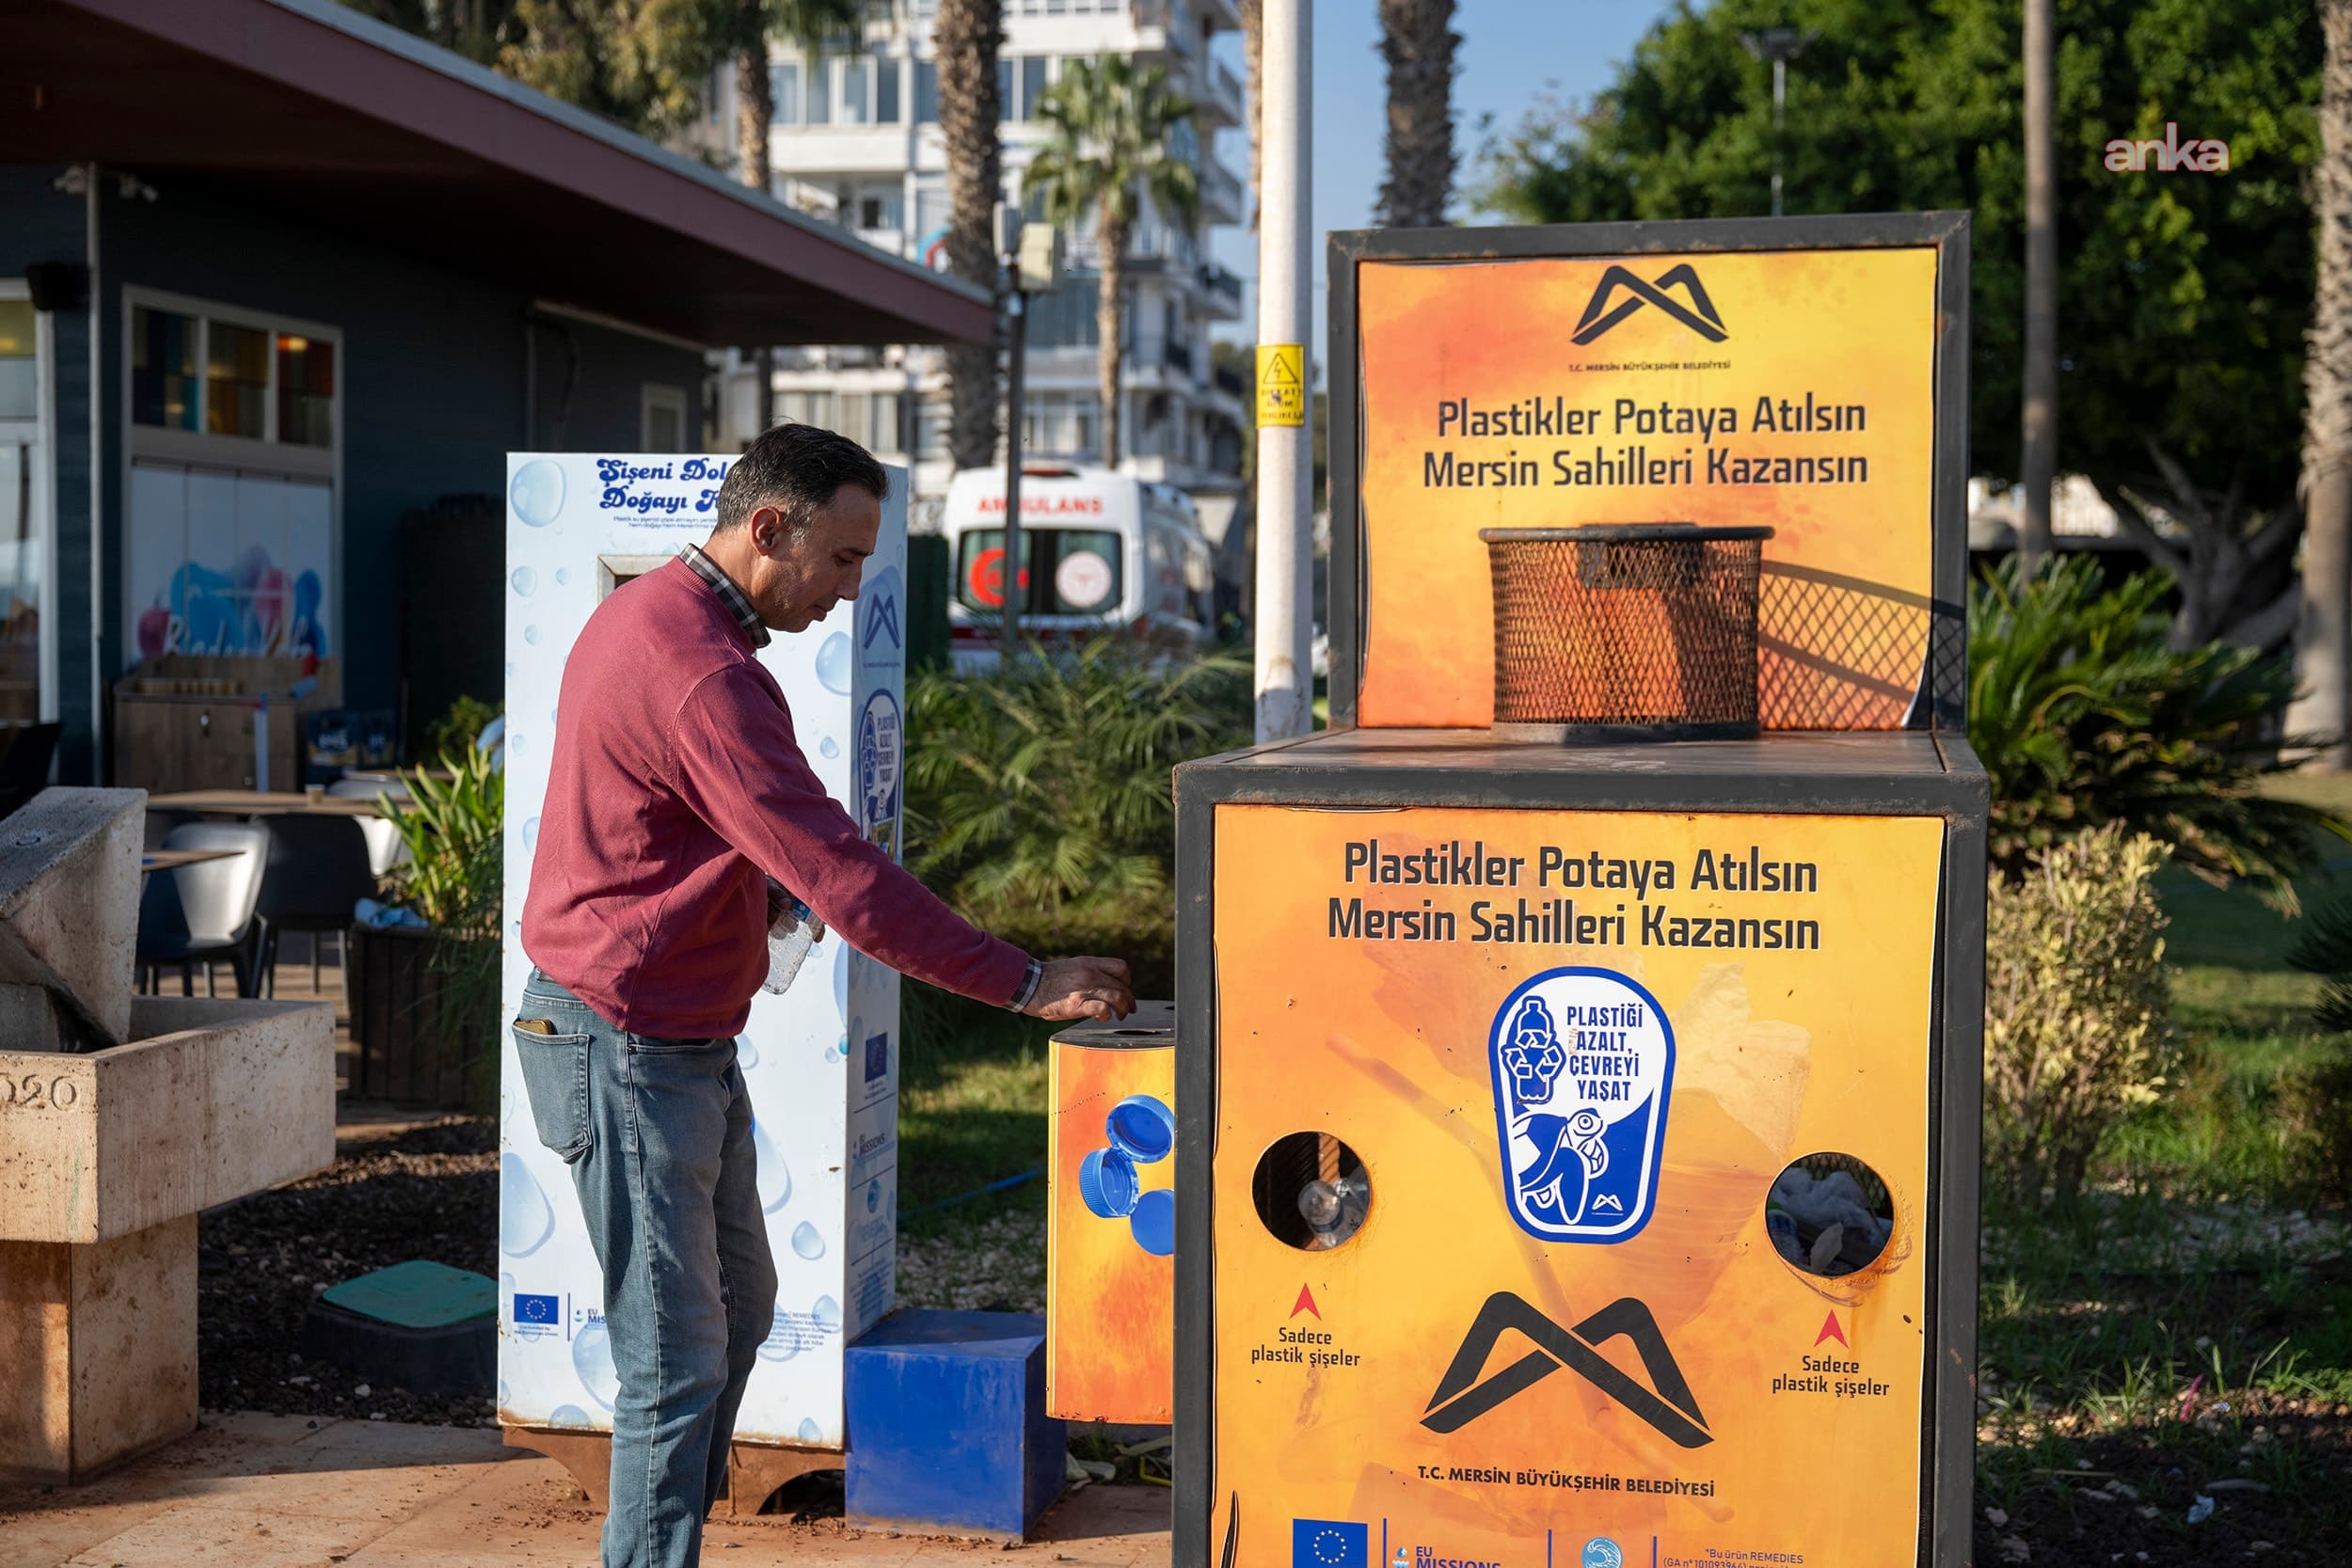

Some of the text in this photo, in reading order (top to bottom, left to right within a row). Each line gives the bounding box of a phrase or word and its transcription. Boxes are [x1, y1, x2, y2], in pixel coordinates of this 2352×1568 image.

[1438, 392, 1866, 444] Plastikler Potaya Atılsın
[596, 457, 727, 487] Şişeni Dol
[1423, 446, 1867, 487] Mersin Sahilleri Kazansın
[599, 485, 688, 514] Doğayı
[977, 497, 1104, 514] AMULANS
[1345, 839, 1817, 900] Plastikler Potaya Atılsın
[1328, 897, 1819, 949] Mersin Sahilleri Kazansın
[1566, 1003, 1643, 1028] PLASTİĞİ
[1576, 1031, 1633, 1054] AZALT,
[1569, 1053, 1639, 1077] ÇEVREYİ
[1577, 1080, 1631, 1101] YAŞAT
[1279, 1326, 1332, 1344] Sadece
[1251, 1344, 1360, 1369] plastik şişeler
[1802, 1354, 1860, 1373] Sadece
[1772, 1373, 1890, 1399] plastik şişeler
[1418, 1465, 1714, 1497] T.C. MERSİN BÜYÜKŞEHİR BELEDİYESİ
[1416, 1545, 1433, 1557] EU
[1724, 1551, 1748, 1561] ürün
[1750, 1551, 1804, 1563] REMEDIES
